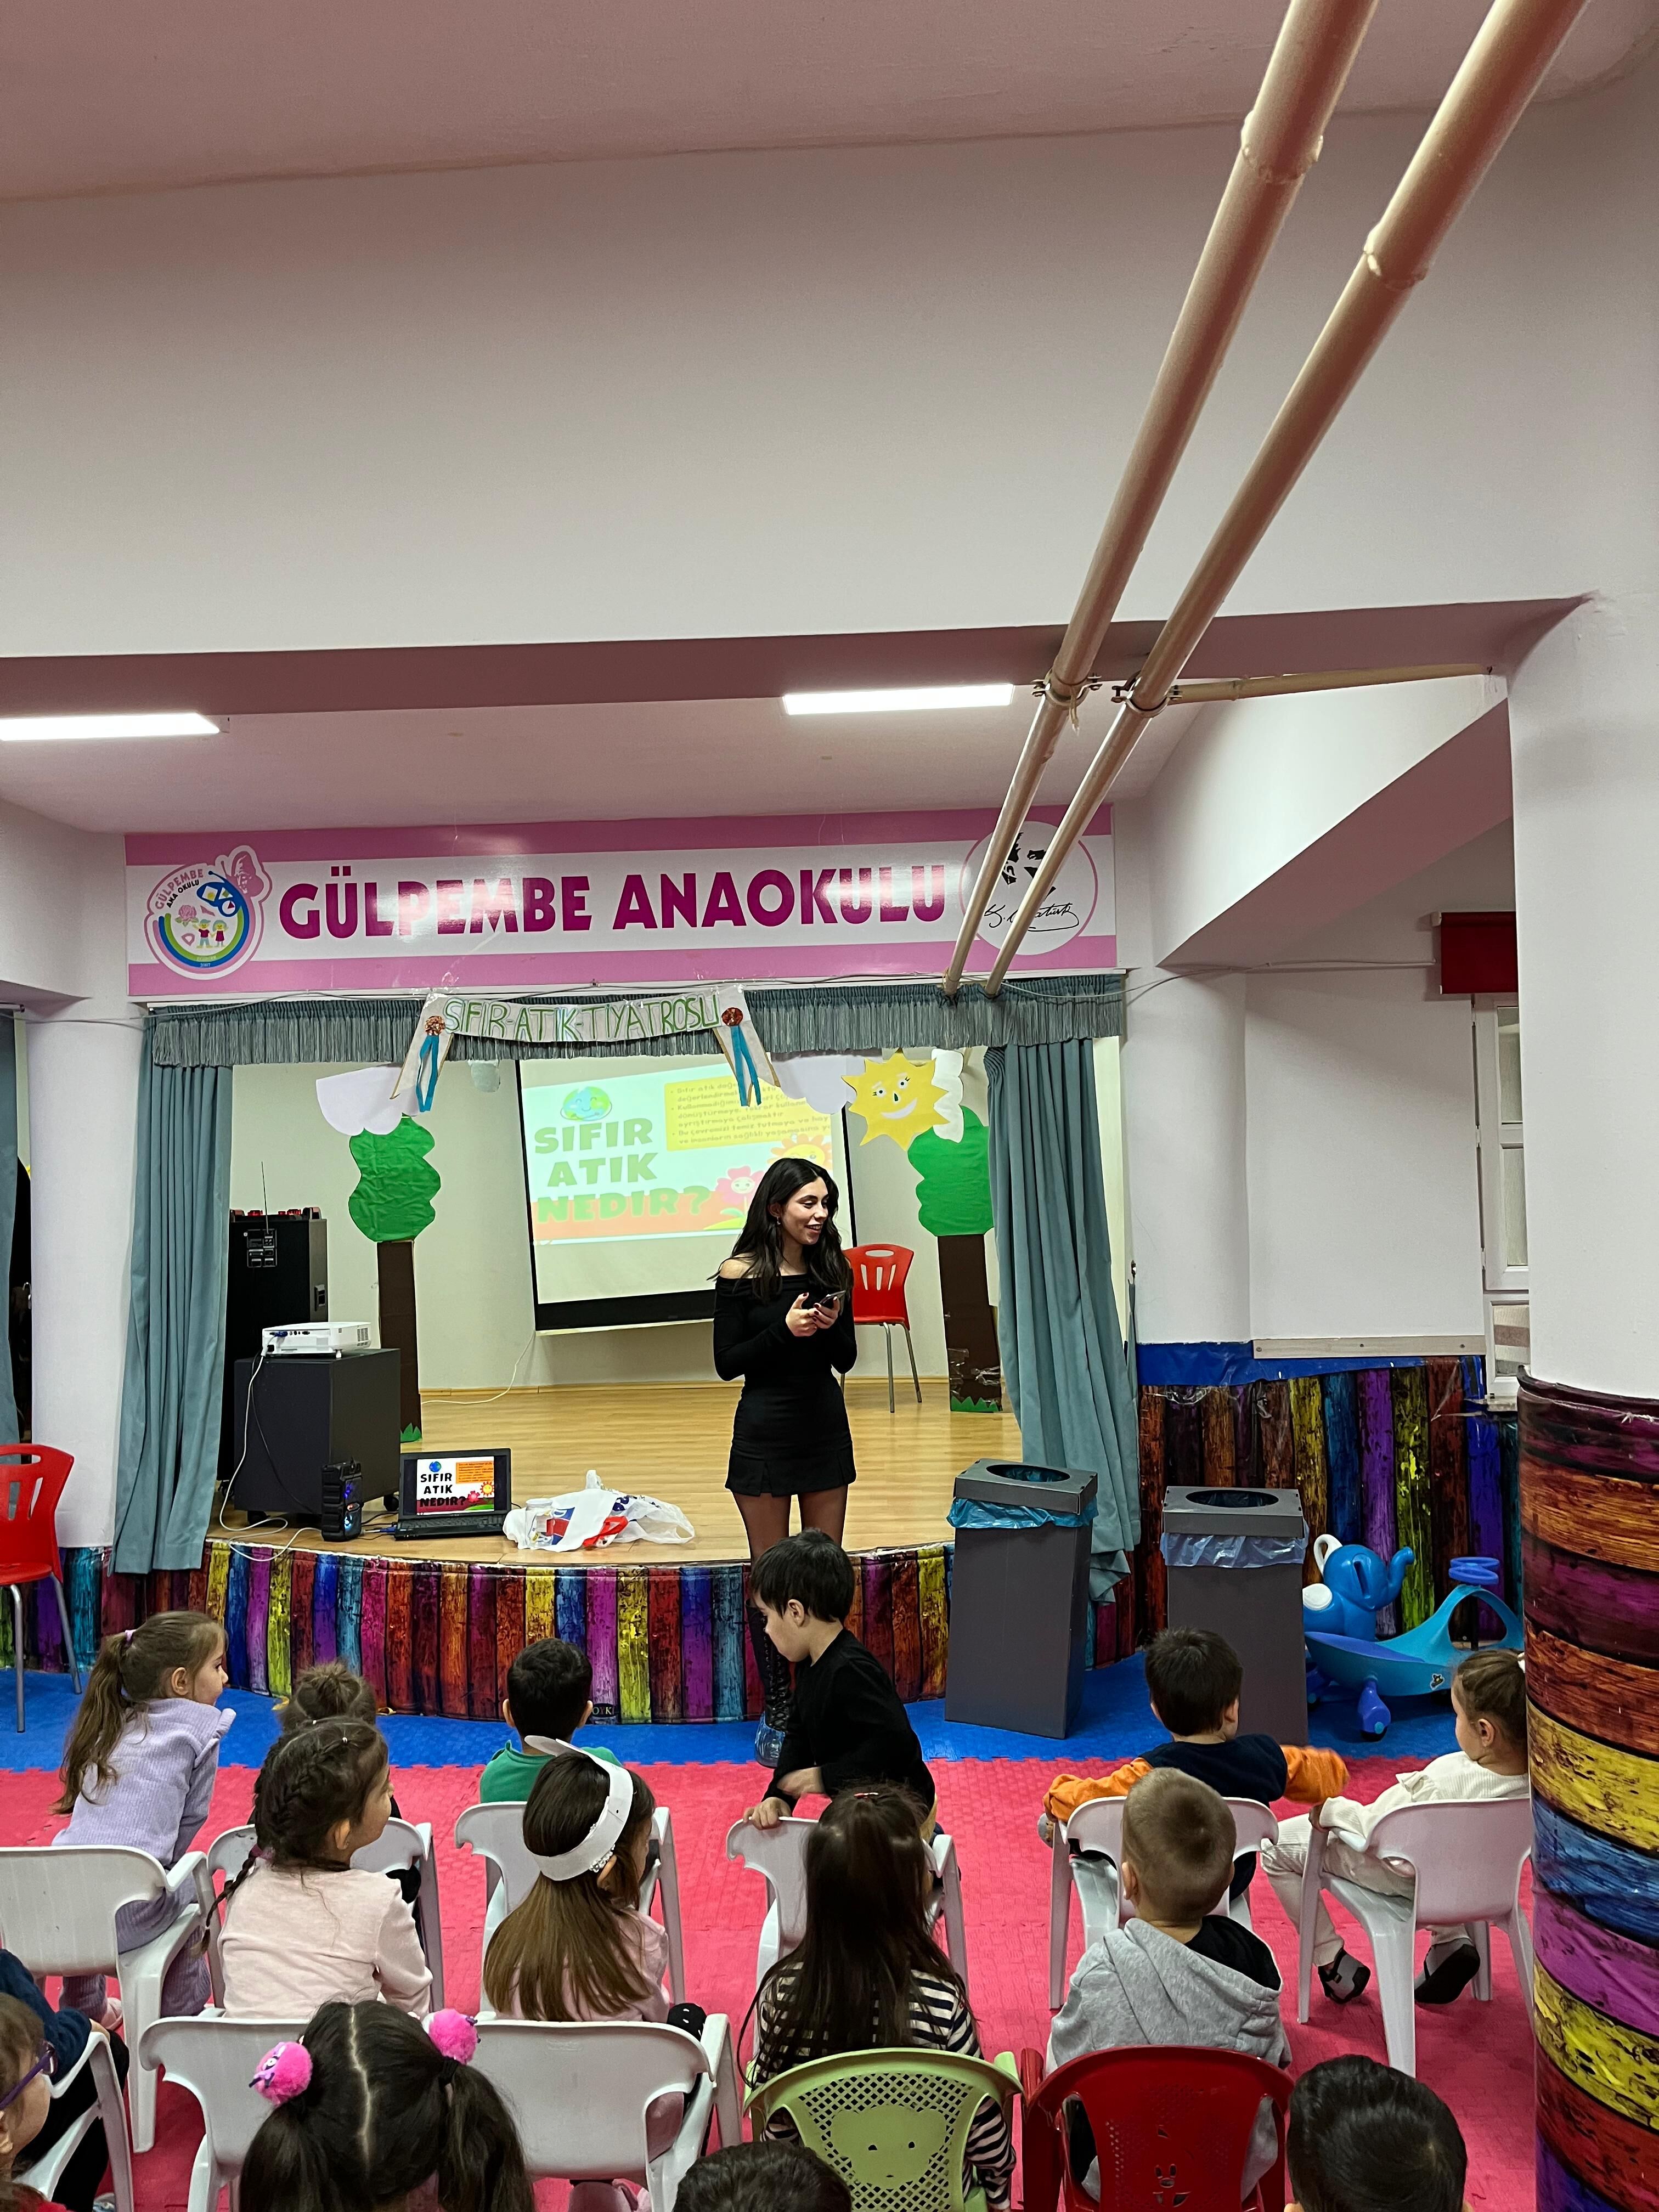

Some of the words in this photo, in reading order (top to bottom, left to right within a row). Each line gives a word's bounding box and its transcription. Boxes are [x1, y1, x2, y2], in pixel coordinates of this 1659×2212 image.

[155, 869, 203, 909] GÜLPEMBE
[167, 894, 178, 908] ANA
[178, 879, 200, 893] OKULU
[279, 866, 592, 939] GÜLPEMBE
[612, 865, 946, 930] ANAOKULU
[534, 1118, 653, 1154] SIFIR
[548, 1153, 658, 1187] ATIK
[420, 1473, 452, 1482] SIFIR
[424, 1485, 453, 1494] ATIK
